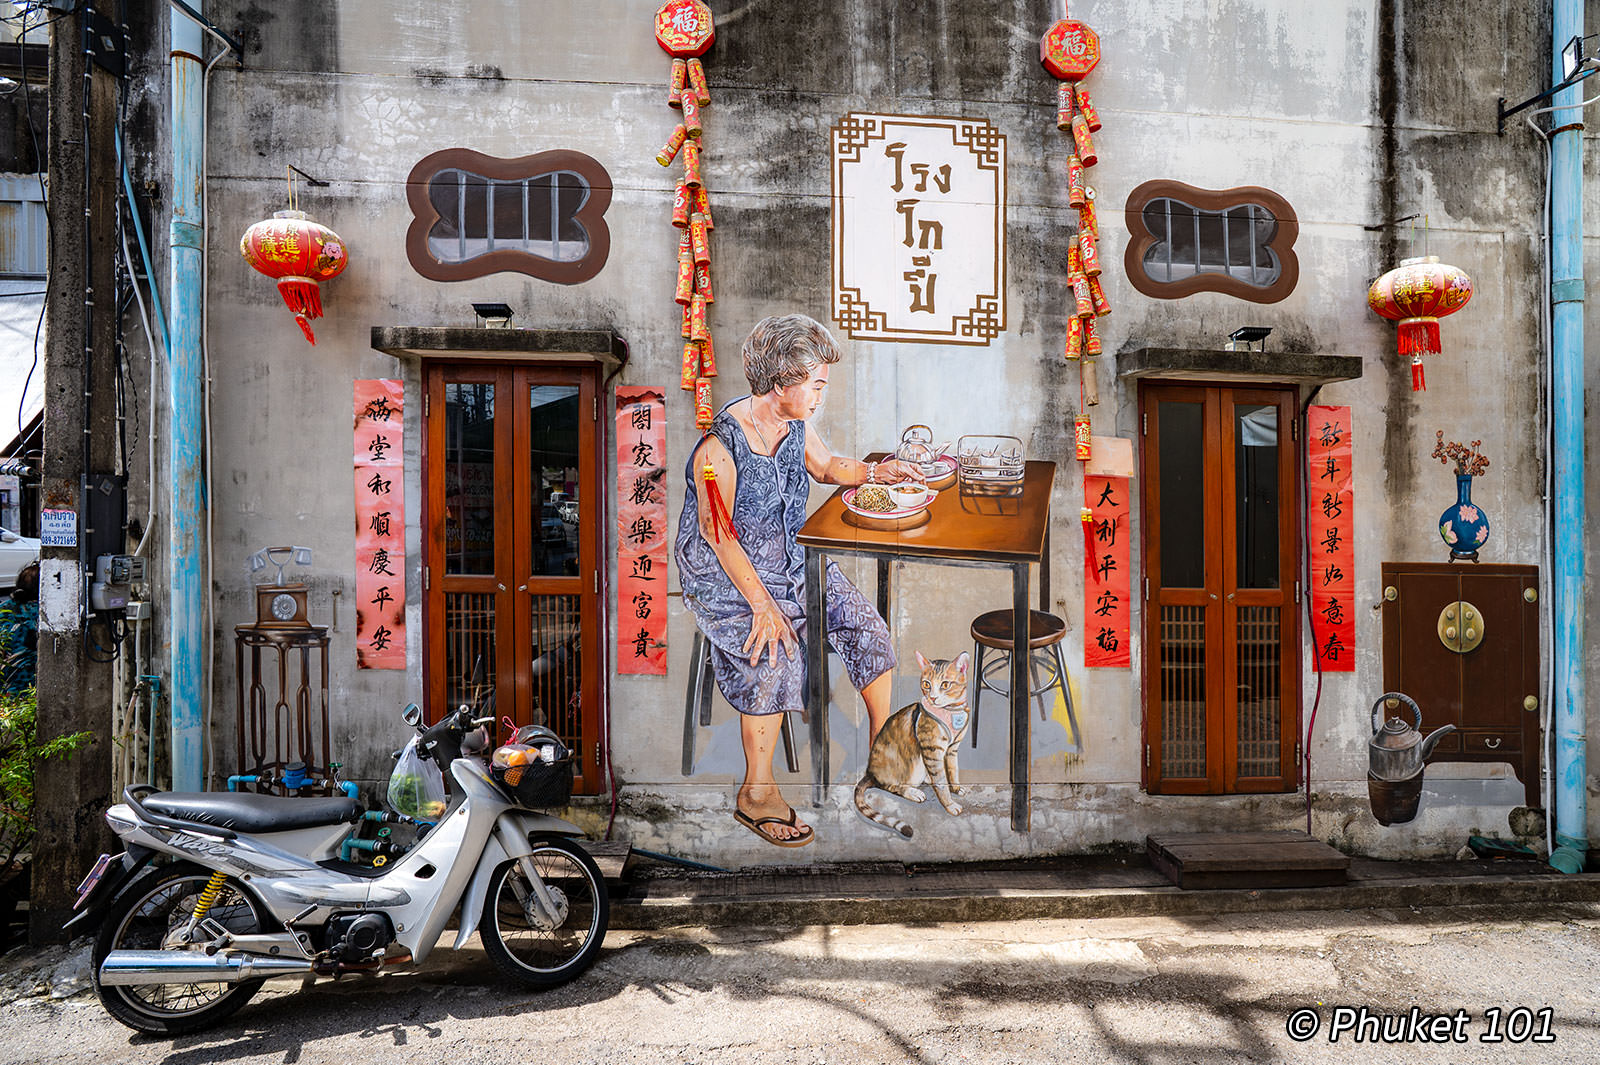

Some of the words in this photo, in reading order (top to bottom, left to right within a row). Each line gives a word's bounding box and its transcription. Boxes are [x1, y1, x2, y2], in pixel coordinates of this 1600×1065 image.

[671, 6, 699, 33] 福
[1061, 30, 1087, 55] 福
[884, 142, 952, 193] โรง
[896, 199, 943, 250] โก
